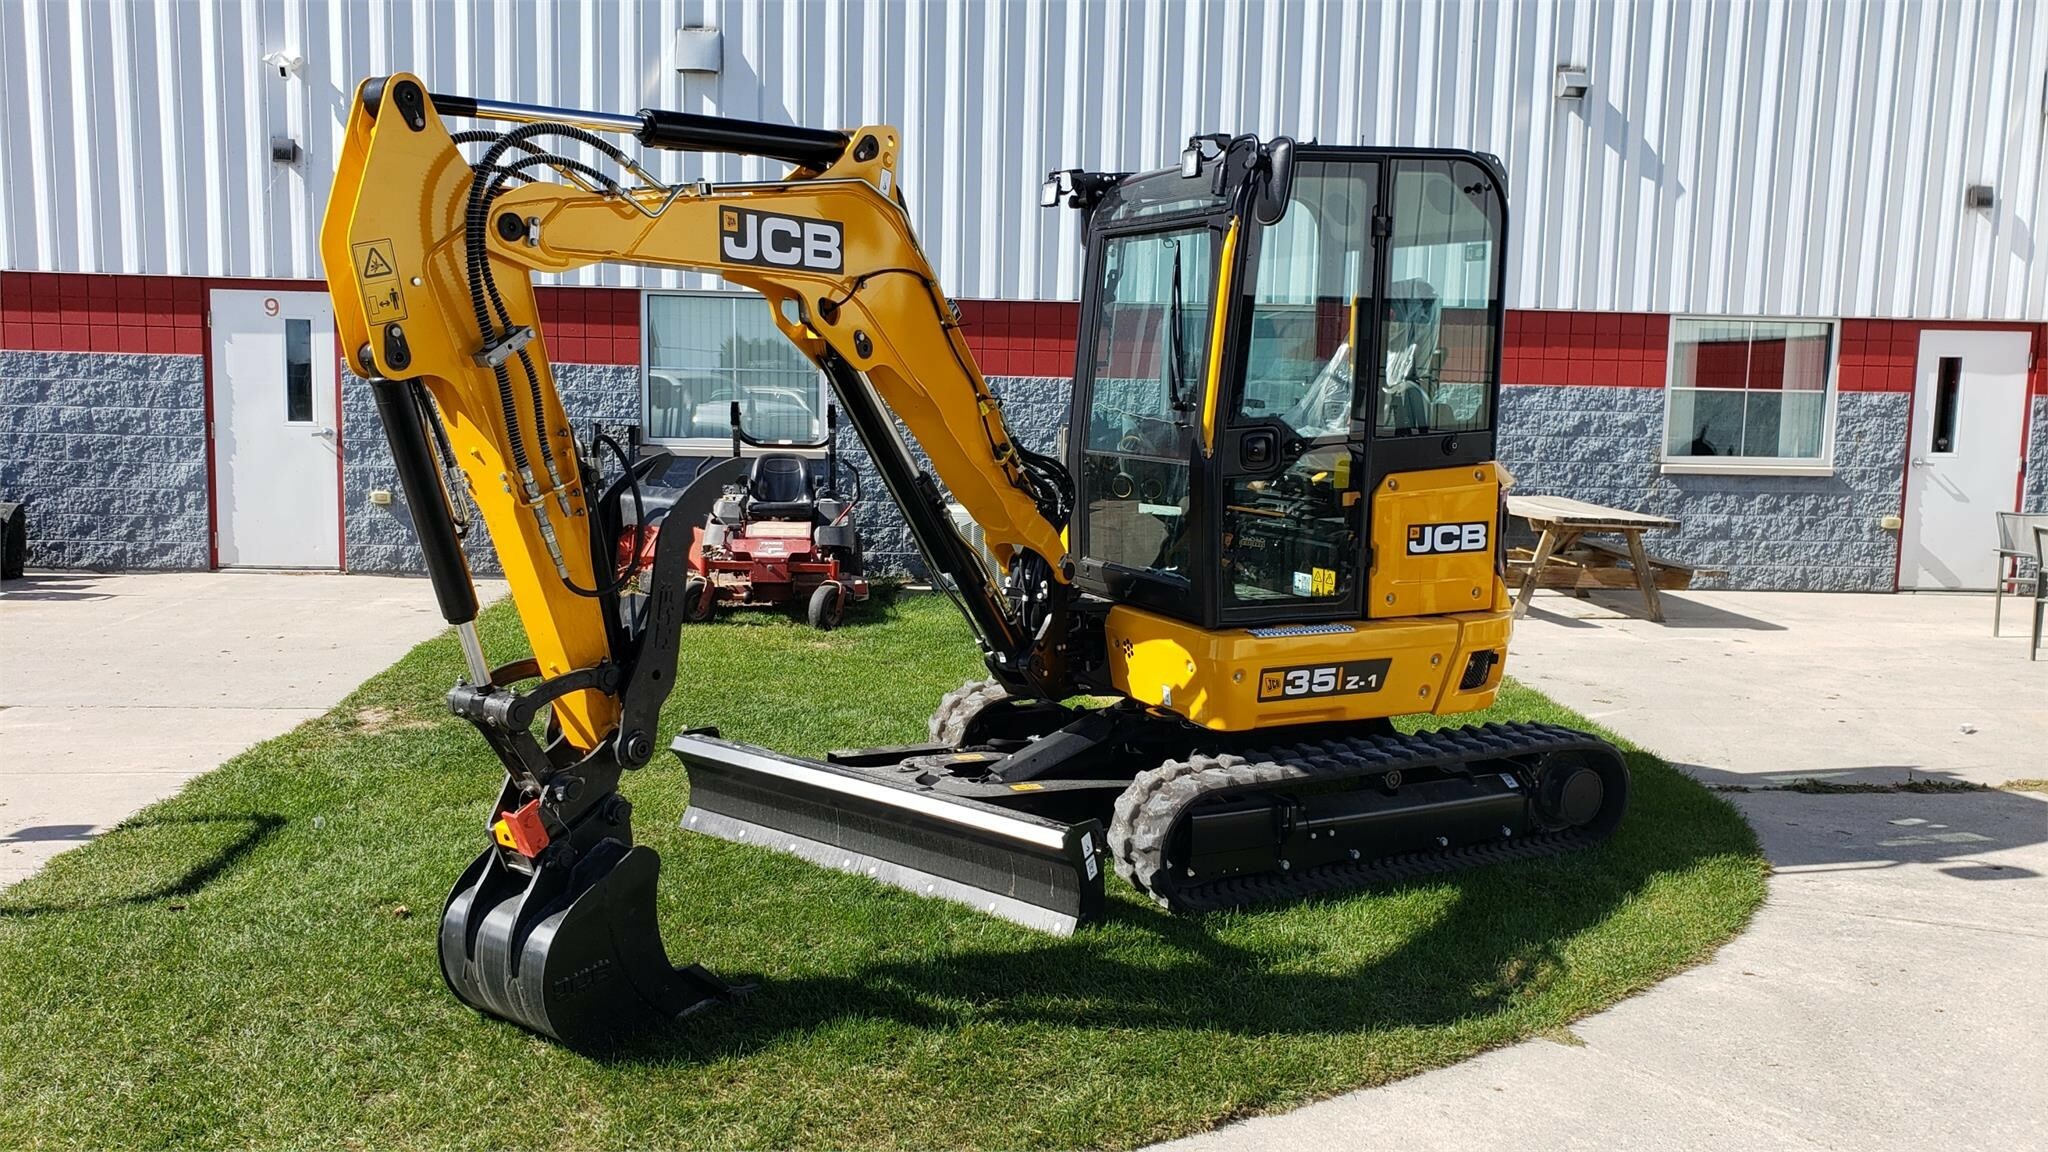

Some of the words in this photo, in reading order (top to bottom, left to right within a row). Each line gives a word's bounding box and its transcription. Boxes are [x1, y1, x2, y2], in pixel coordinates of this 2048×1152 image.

[724, 214, 841, 269] JCB
[264, 298, 280, 317] 9
[1409, 524, 1486, 553] JCB
[1285, 668, 1336, 695] 35
[1345, 674, 1377, 690] Z-1
